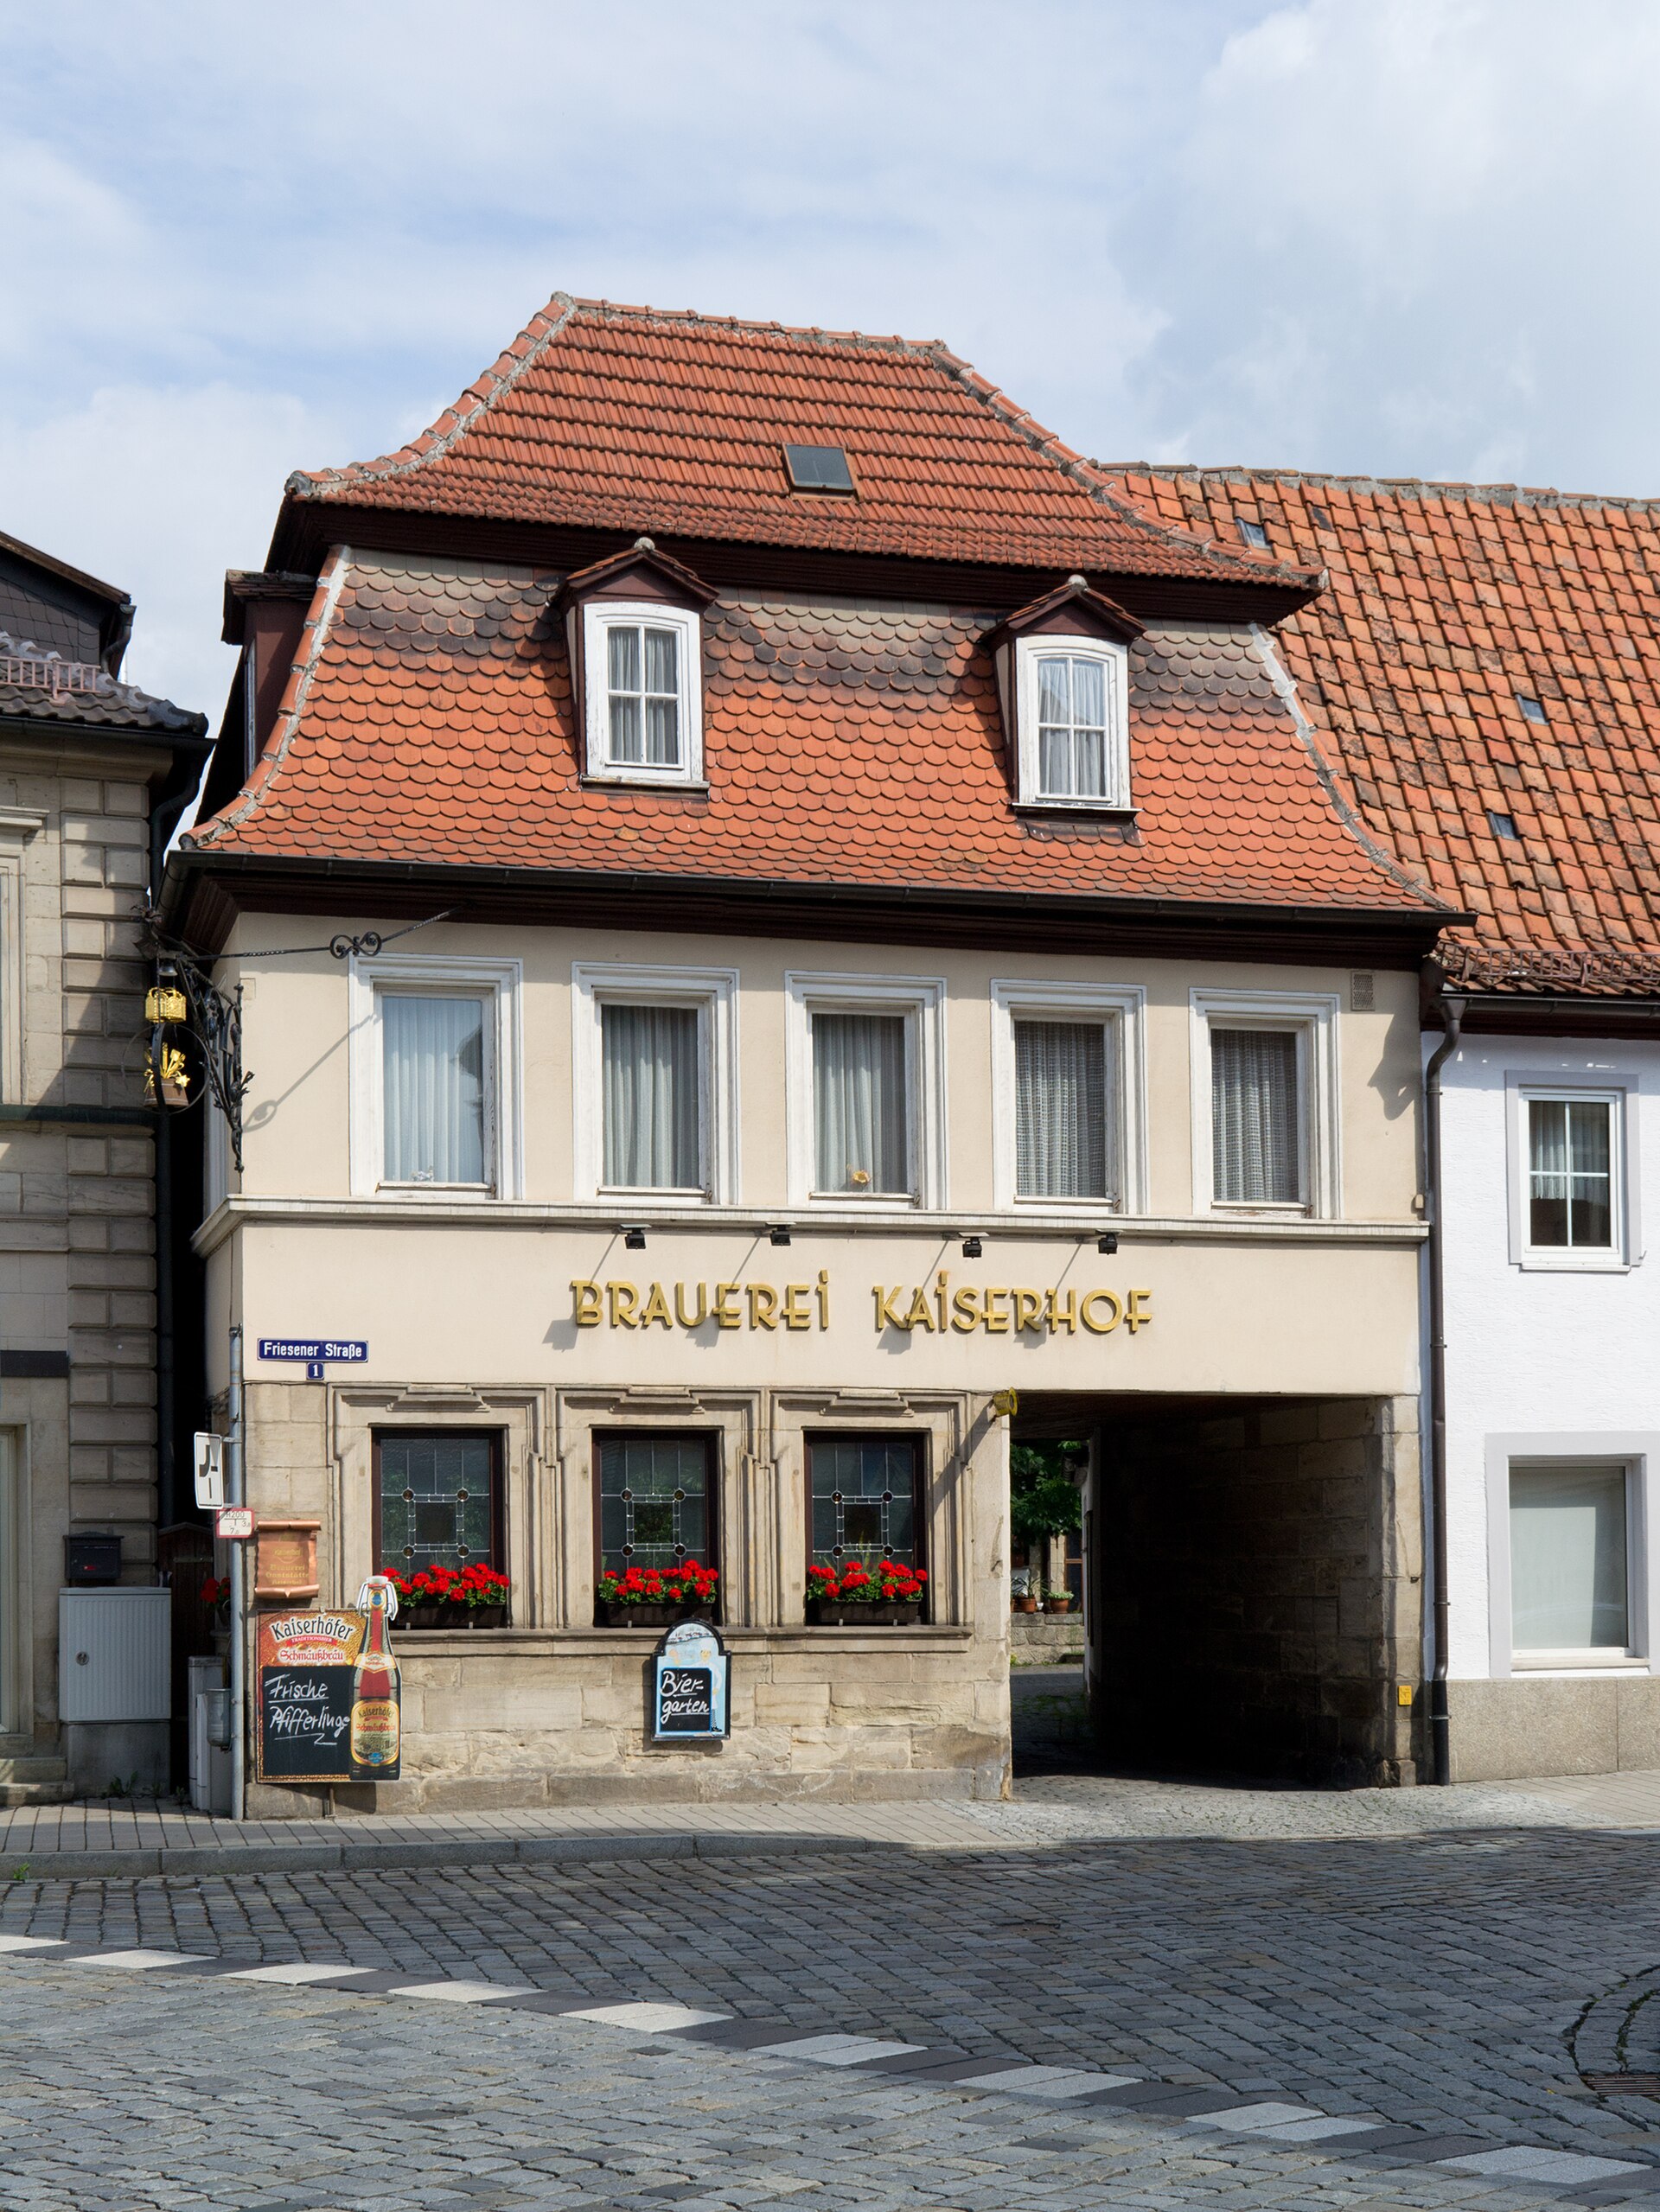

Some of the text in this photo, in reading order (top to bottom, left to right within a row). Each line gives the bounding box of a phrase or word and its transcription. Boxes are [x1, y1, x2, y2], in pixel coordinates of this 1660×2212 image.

[264, 1342, 362, 1359] Friesener Straße
[312, 1364, 319, 1377] 1
[271, 1616, 354, 1641] Kaiserhöfer
[264, 1673, 329, 1699] Frische
[269, 1705, 350, 1738] Pfifferlinge
[660, 1698, 710, 1724] garten
